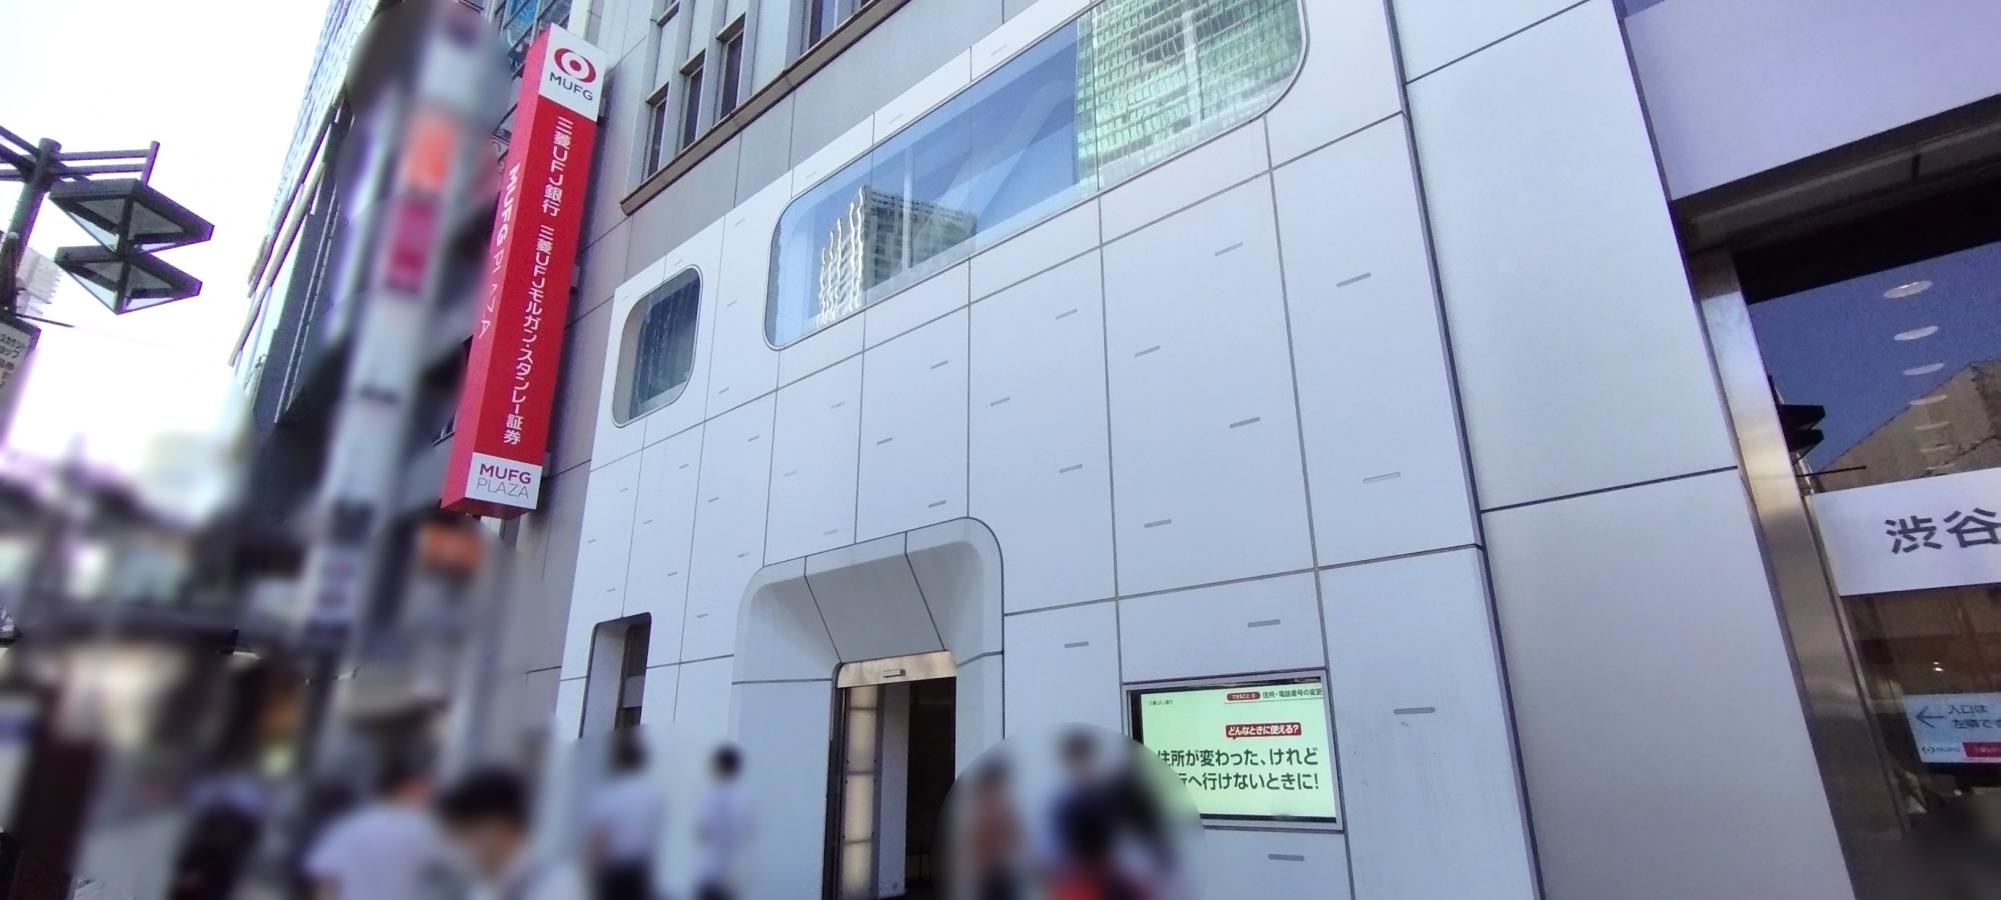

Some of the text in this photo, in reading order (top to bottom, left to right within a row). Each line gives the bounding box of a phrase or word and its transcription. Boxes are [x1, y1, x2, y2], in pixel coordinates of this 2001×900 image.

[550, 72, 593, 101] MUFG
[496, 162, 520, 247] MUFG
[503, 116, 574, 446] 三菱UFJ銀行 三菱UFJモルガン・スタンレー証券
[476, 477, 530, 499] PLAZA
[479, 463, 531, 485] MUFG
[1884, 507, 2001, 554] 渋谷
